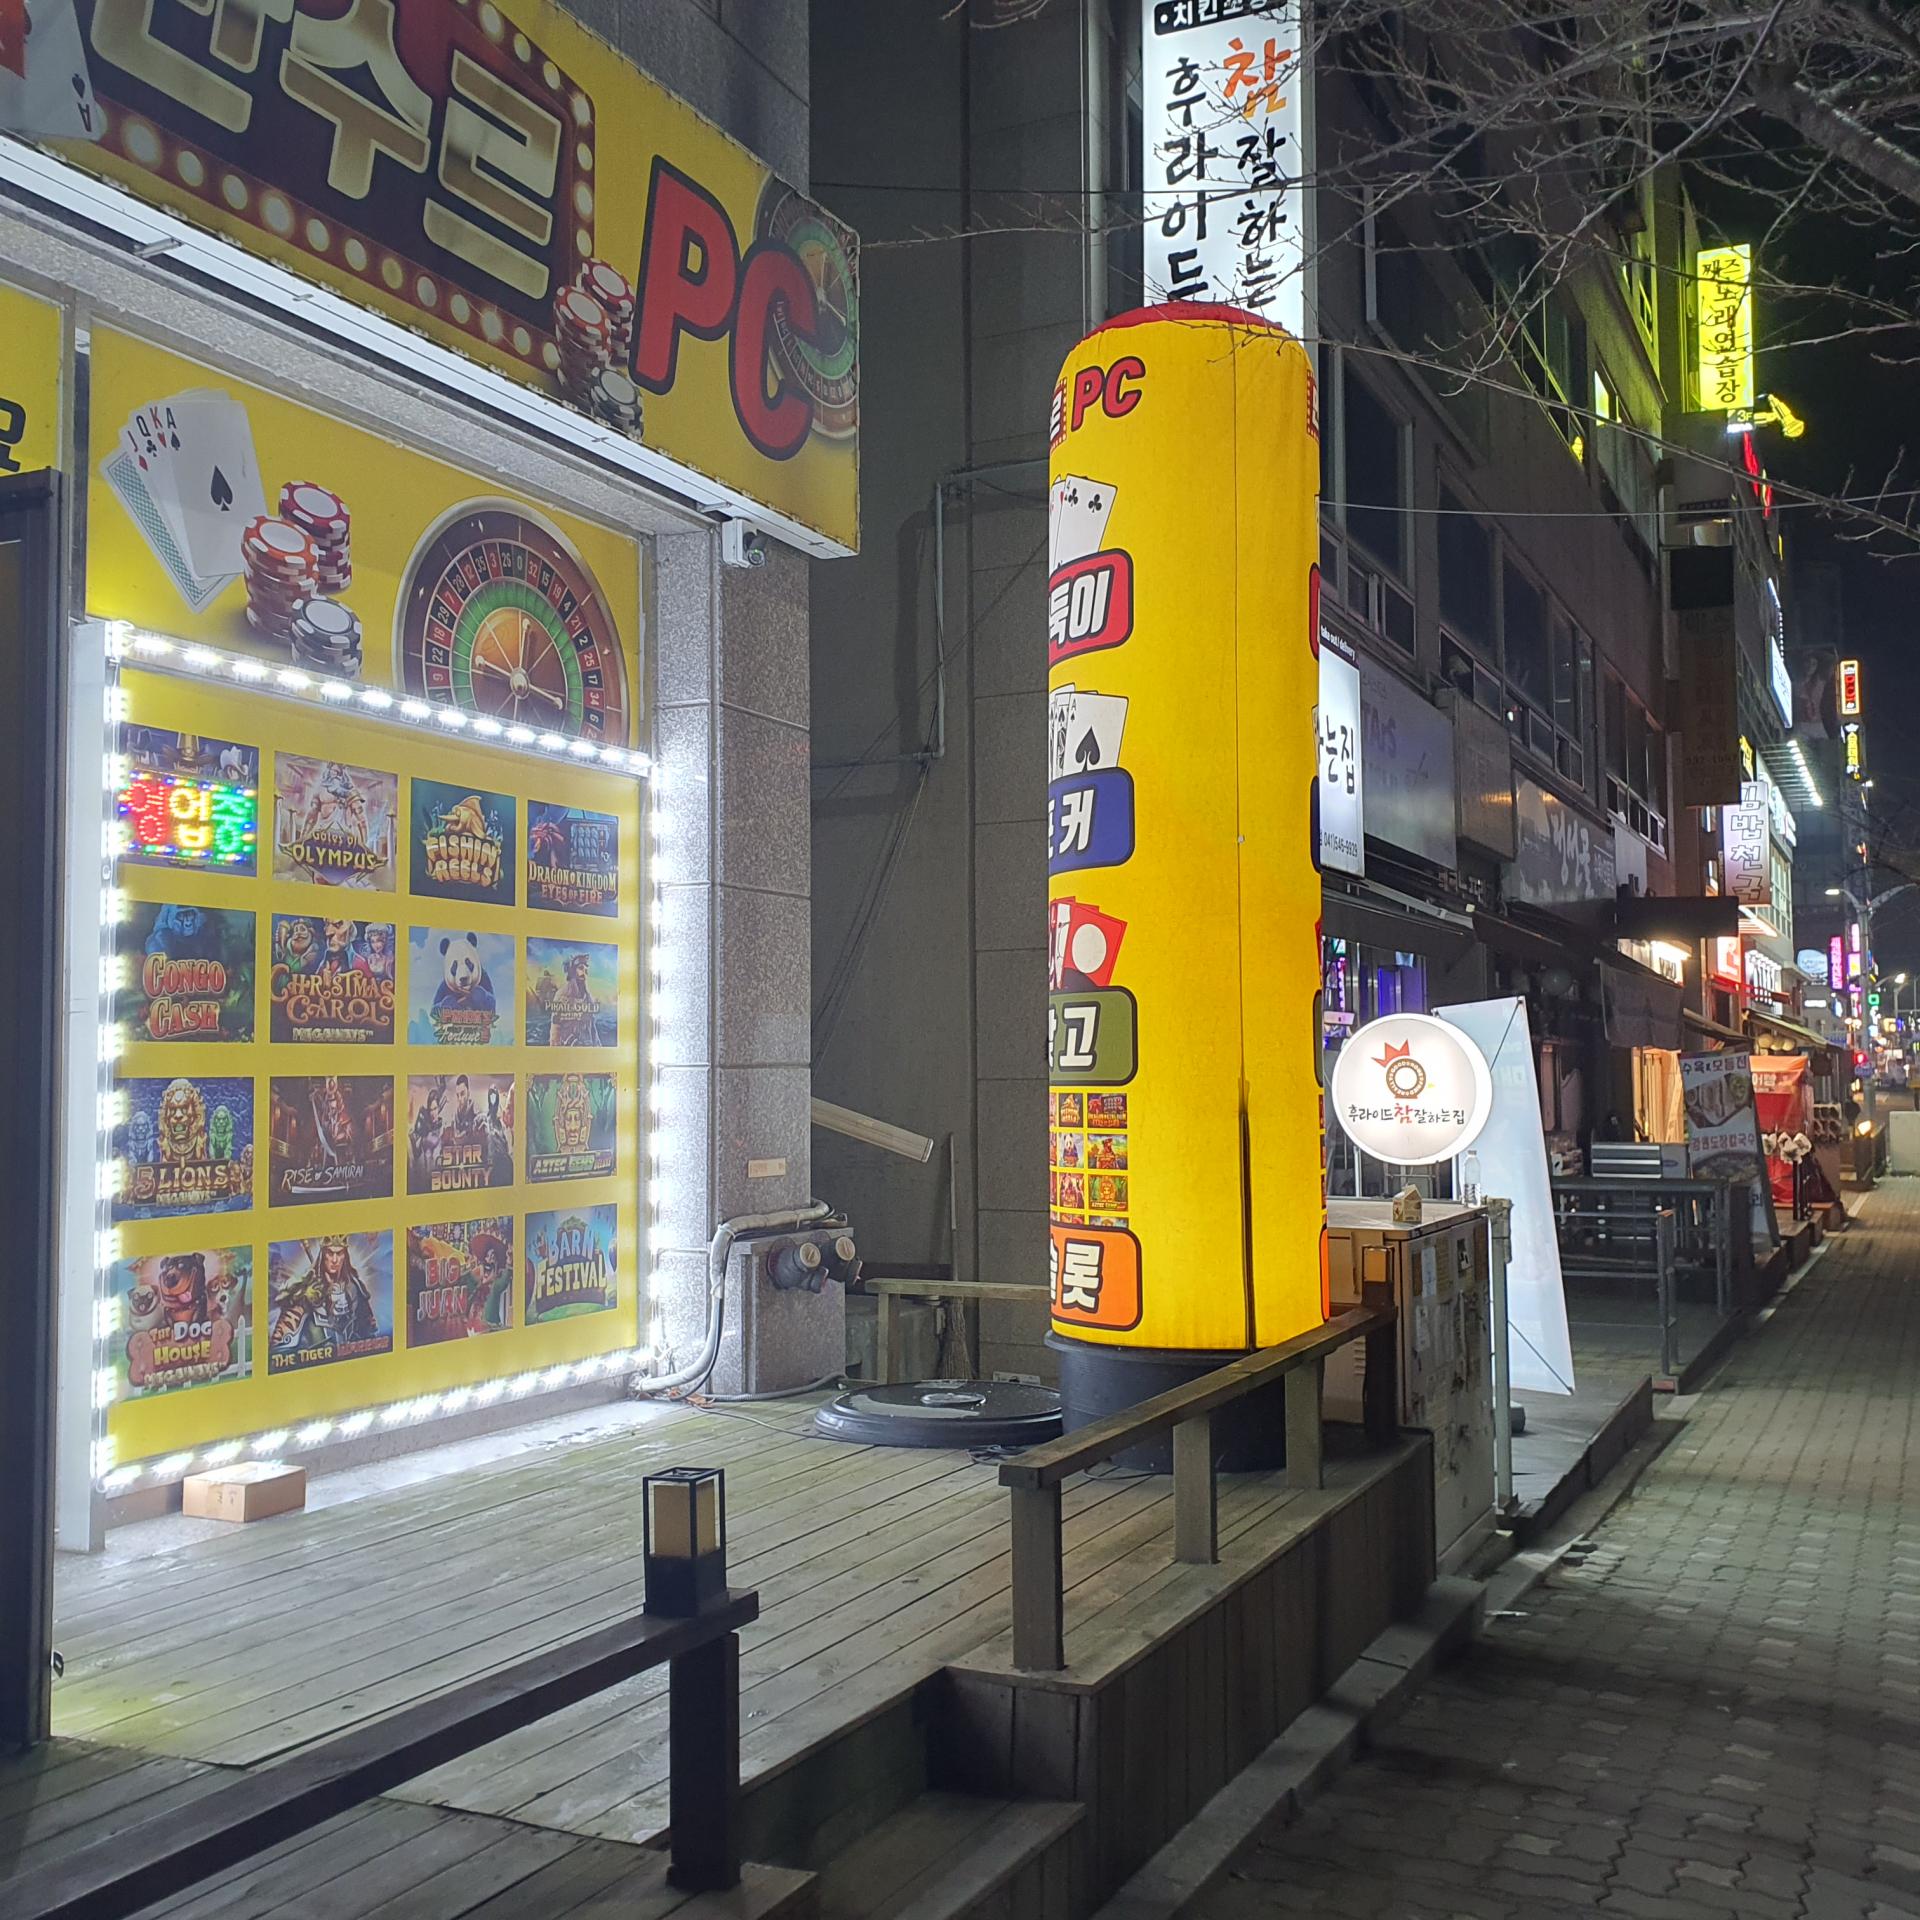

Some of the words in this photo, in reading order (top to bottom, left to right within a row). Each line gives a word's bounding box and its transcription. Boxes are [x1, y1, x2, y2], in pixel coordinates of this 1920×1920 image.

[1161, 57, 1219, 302] 후라이드
[628, 153, 827, 462] PC
[1713, 277, 1741, 403] 노래연습장
[1071, 356, 1147, 432] PC
[127, 430, 139, 452] J
[136, 415, 151, 437] Q
[150, 406, 163, 429] K
[166, 407, 178, 429] A
[1736, 409, 1753, 421] 3F
[475, 556, 487, 573] 35
[490, 552, 498, 568] 3
[502, 552, 512, 568] 26
[516, 554, 523, 570] 0
[528, 562, 538, 578] 32
[542, 571, 550, 586] 15
[552, 583, 562, 598] 19
[563, 600, 572, 612] 4
[584, 652, 595, 667] 25
[589, 692, 600, 706] 34
[127, 782, 250, 853] 영업중
[1049, 788, 1095, 866] 커
[292, 844, 376, 871] OLYMPUS
[426, 834, 501, 868] FISHIN
[1730, 785, 1765, 901] 김밥천국
[434, 858, 494, 888] REELS
[527, 860, 568, 888] DRAGON
[576, 871, 617, 892] KINGDOM
[541, 884, 567, 901] EYES
[579, 891, 603, 905] FIRE
[143, 952, 226, 998] CONGO
[270, 963, 395, 1010] CHRISTMAS
[148, 997, 220, 1039] CASH
[286, 994, 390, 1025] CAROL
[1049, 1005, 1097, 1069] 고
[442, 1143, 482, 1166] STAR
[134, 1166, 155, 1200] 5
[158, 1164, 228, 1190] LIONS
[281, 1168, 314, 1191] RISE
[325, 1165, 364, 1185] SAMURAI
[431, 1168, 493, 1191] BOUNTY
[547, 1227, 594, 1265] BARN
[424, 1256, 461, 1289] BIG
[536, 1253, 608, 1300] FESTIVAL
[417, 1284, 468, 1322] JUAN
[173, 1321, 212, 1342] DOG
[153, 1341, 212, 1366] HOUSE
[271, 1354, 295, 1368] THE
[297, 1346, 333, 1363] TIGER
